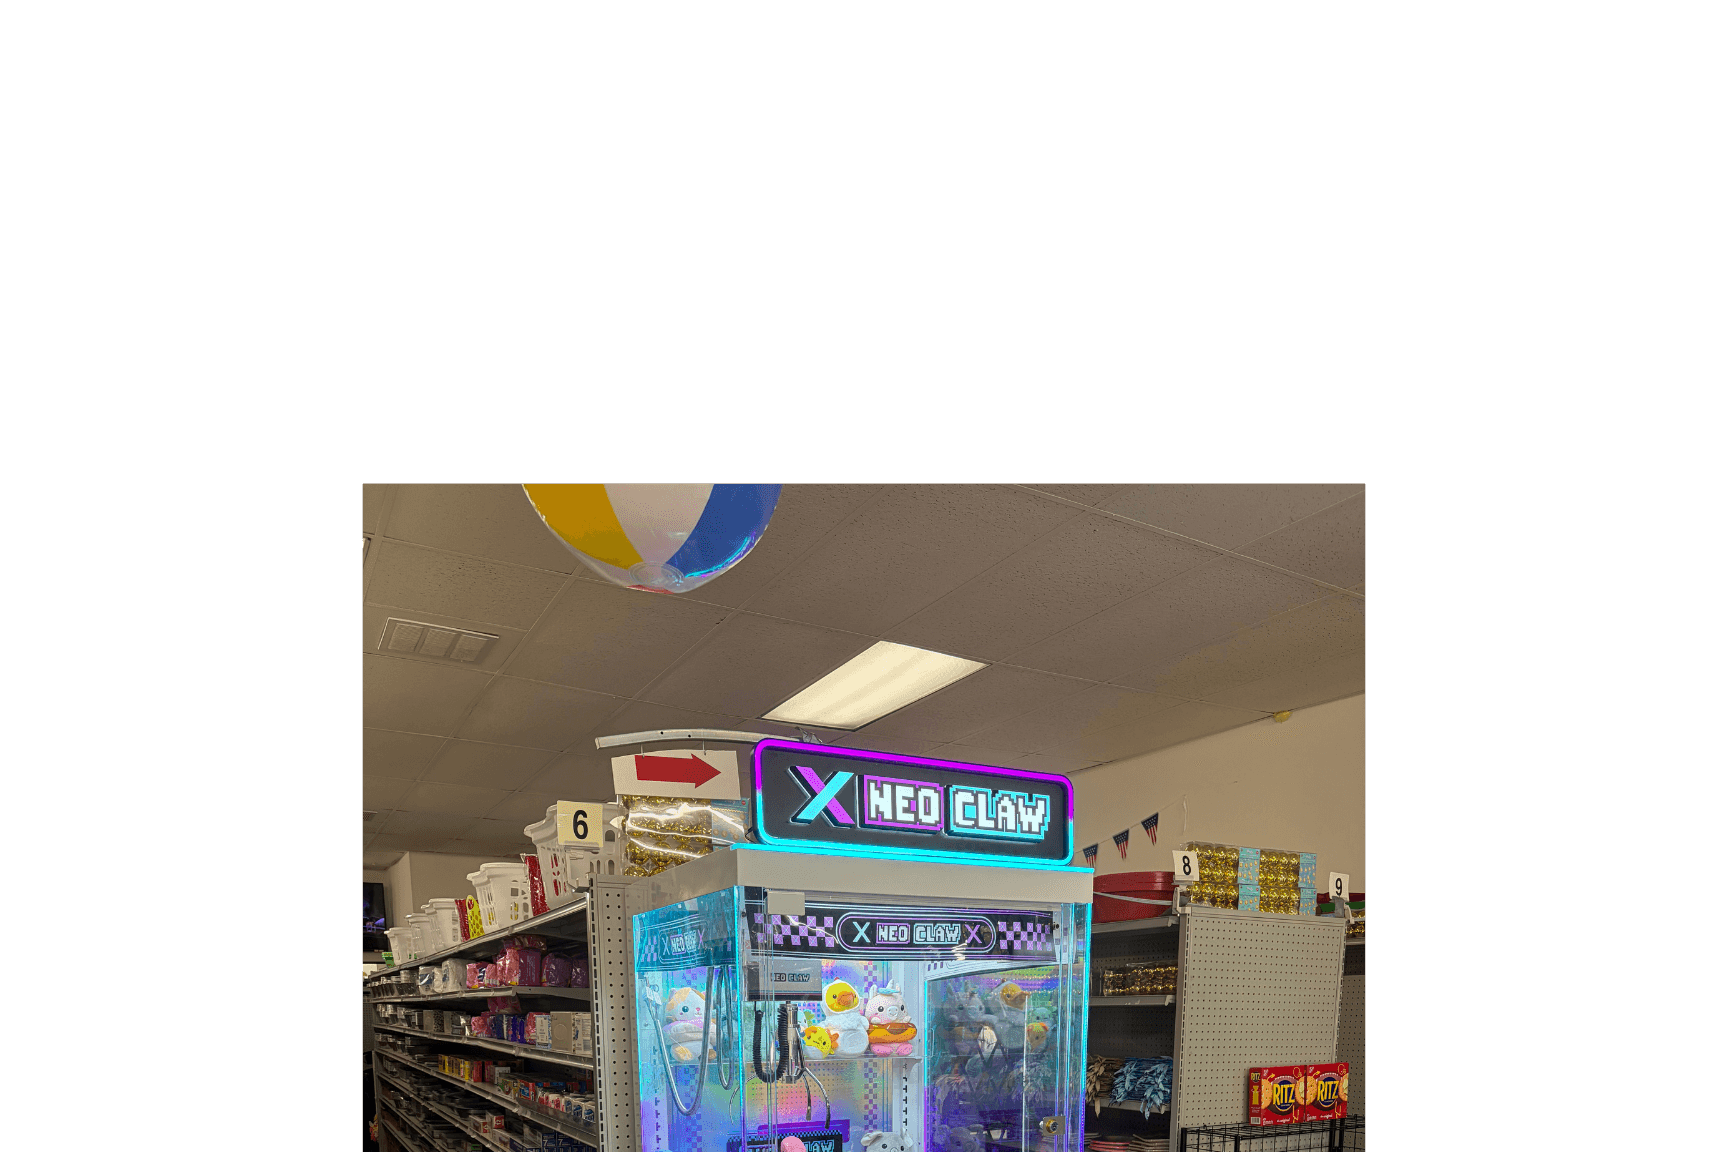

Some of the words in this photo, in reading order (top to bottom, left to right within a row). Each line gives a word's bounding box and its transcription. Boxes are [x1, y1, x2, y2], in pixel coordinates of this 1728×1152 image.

[868, 781, 941, 825] NEO
[953, 788, 1047, 834] CLAW
[572, 809, 589, 839] 6
[1182, 855, 1192, 875] 8
[1335, 877, 1343, 896] 9
[877, 923, 909, 943] NEO
[914, 924, 961, 943] CLAW
[788, 973, 810, 982] CLAW
[1251, 1072, 1261, 1080] RITZ
[1273, 1083, 1295, 1106] RITZ
[1317, 1080, 1339, 1101] RITZ
